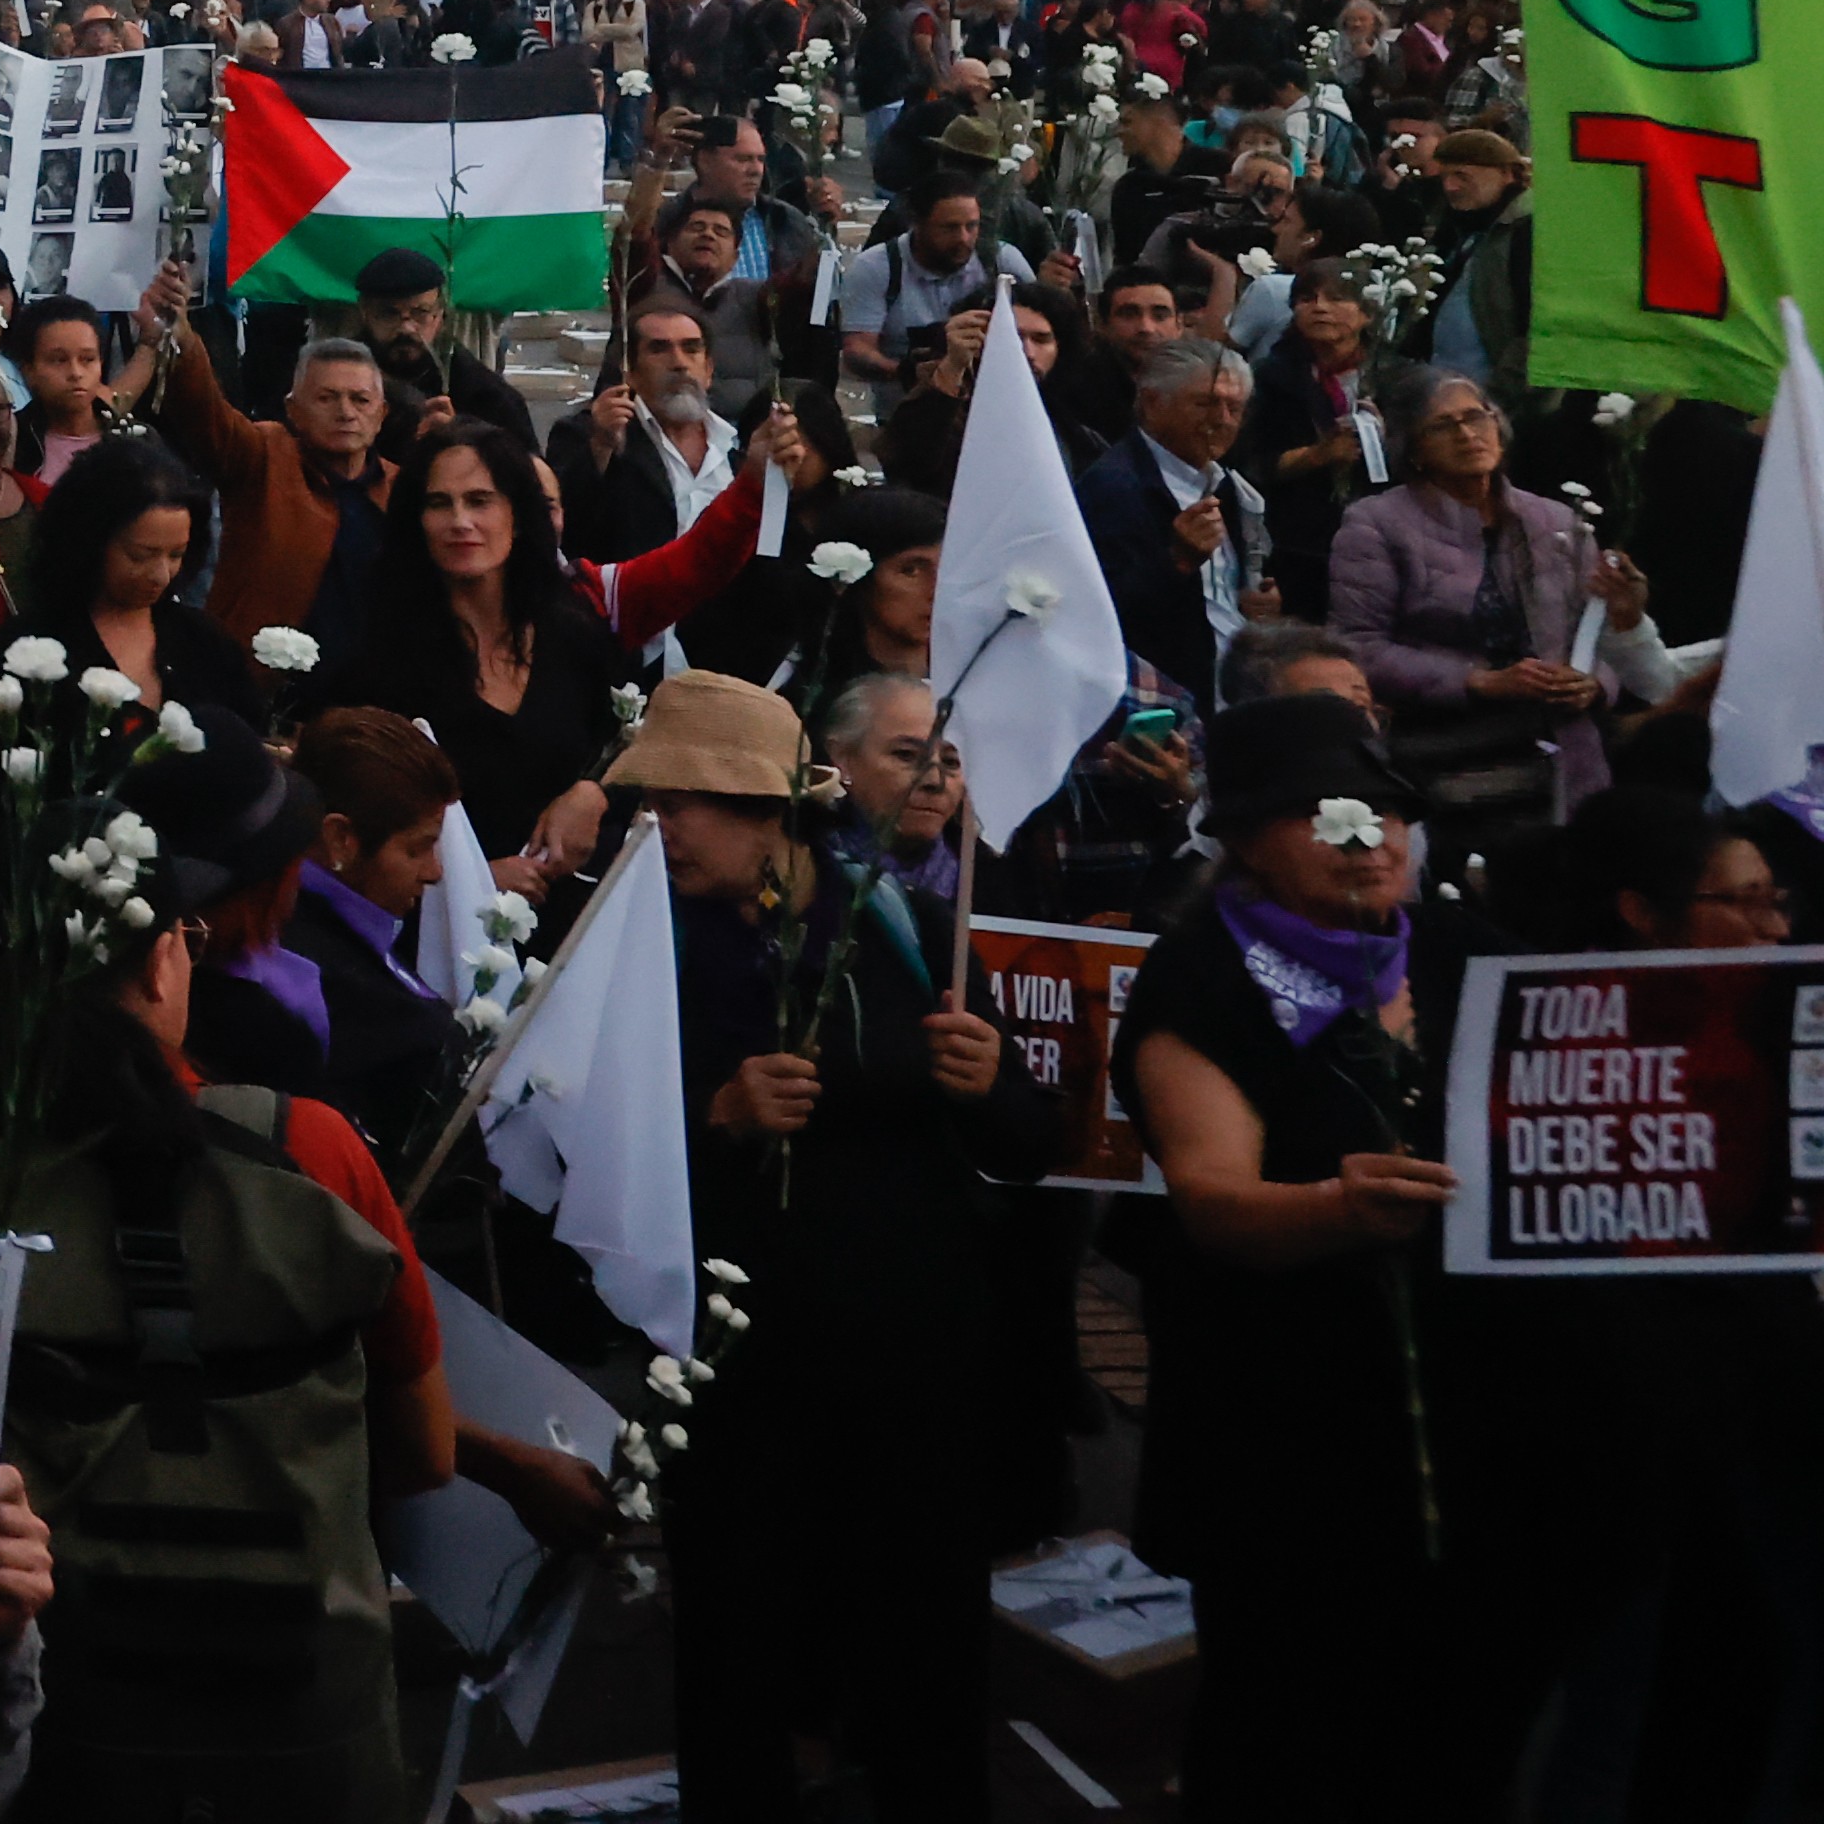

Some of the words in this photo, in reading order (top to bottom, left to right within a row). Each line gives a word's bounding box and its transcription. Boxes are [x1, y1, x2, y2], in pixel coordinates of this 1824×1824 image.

[1013, 973, 1074, 1024] VIDA
[1519, 984, 1629, 1041] TODA
[1506, 1045, 1690, 1106] MUERTE
[1506, 1115, 1620, 1175] DEBE
[1629, 1112, 1717, 1172] SER
[1508, 1180, 1711, 1245] LLORADA
